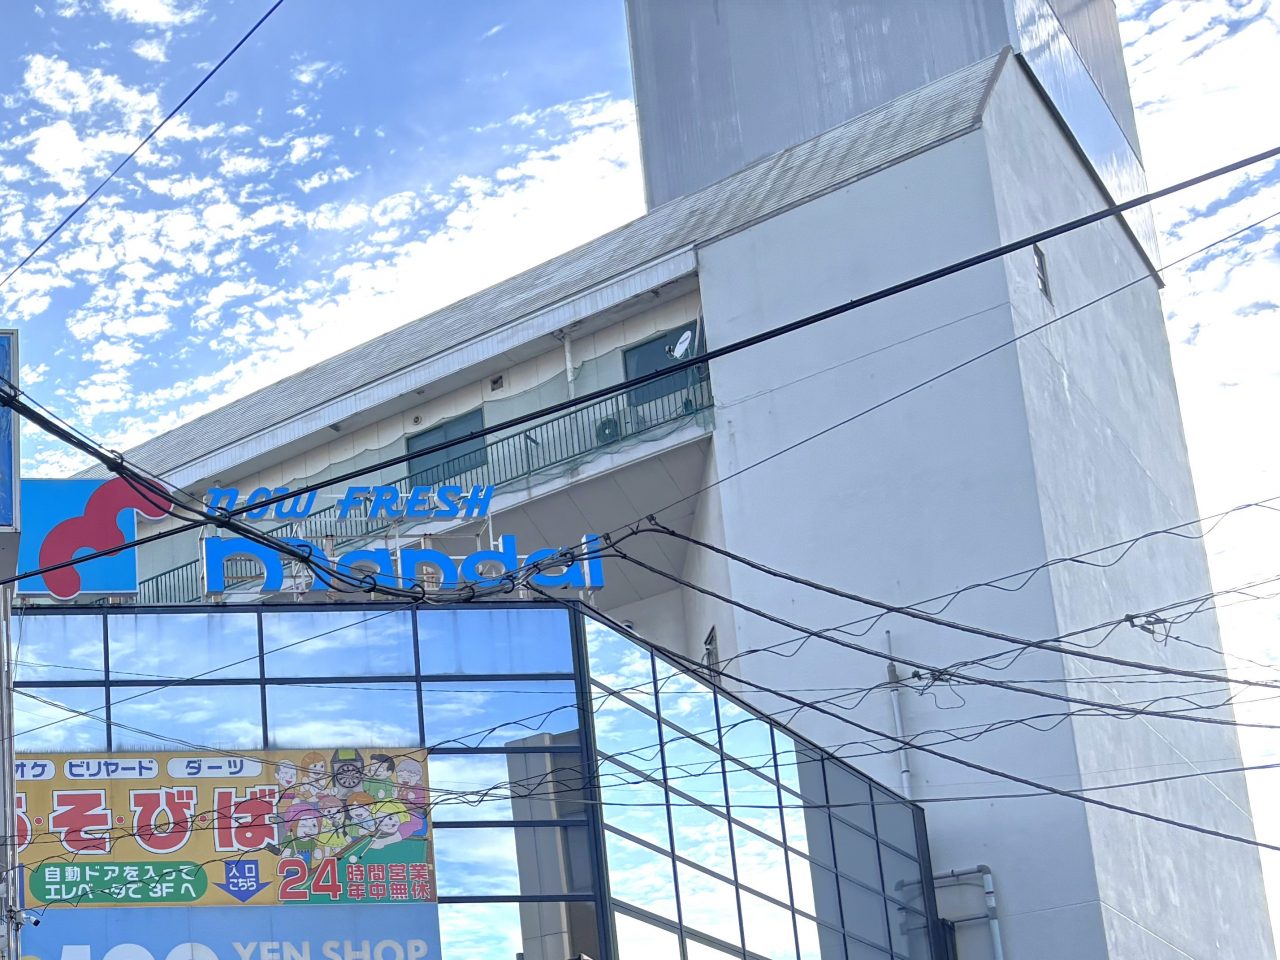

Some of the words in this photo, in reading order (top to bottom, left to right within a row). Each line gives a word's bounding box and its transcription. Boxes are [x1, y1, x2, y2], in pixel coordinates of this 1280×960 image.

[336, 485, 495, 520] FRESH
[68, 759, 154, 778] ビリヤード
[185, 759, 245, 777] ダーツ
[44, 865, 195, 882] 自動ドアを入って
[229, 864, 256, 877] 入口
[277, 857, 342, 901] 24
[346, 863, 429, 882] 時間営業
[229, 877, 257, 891] こちら
[346, 882, 431, 900] 年中無休
